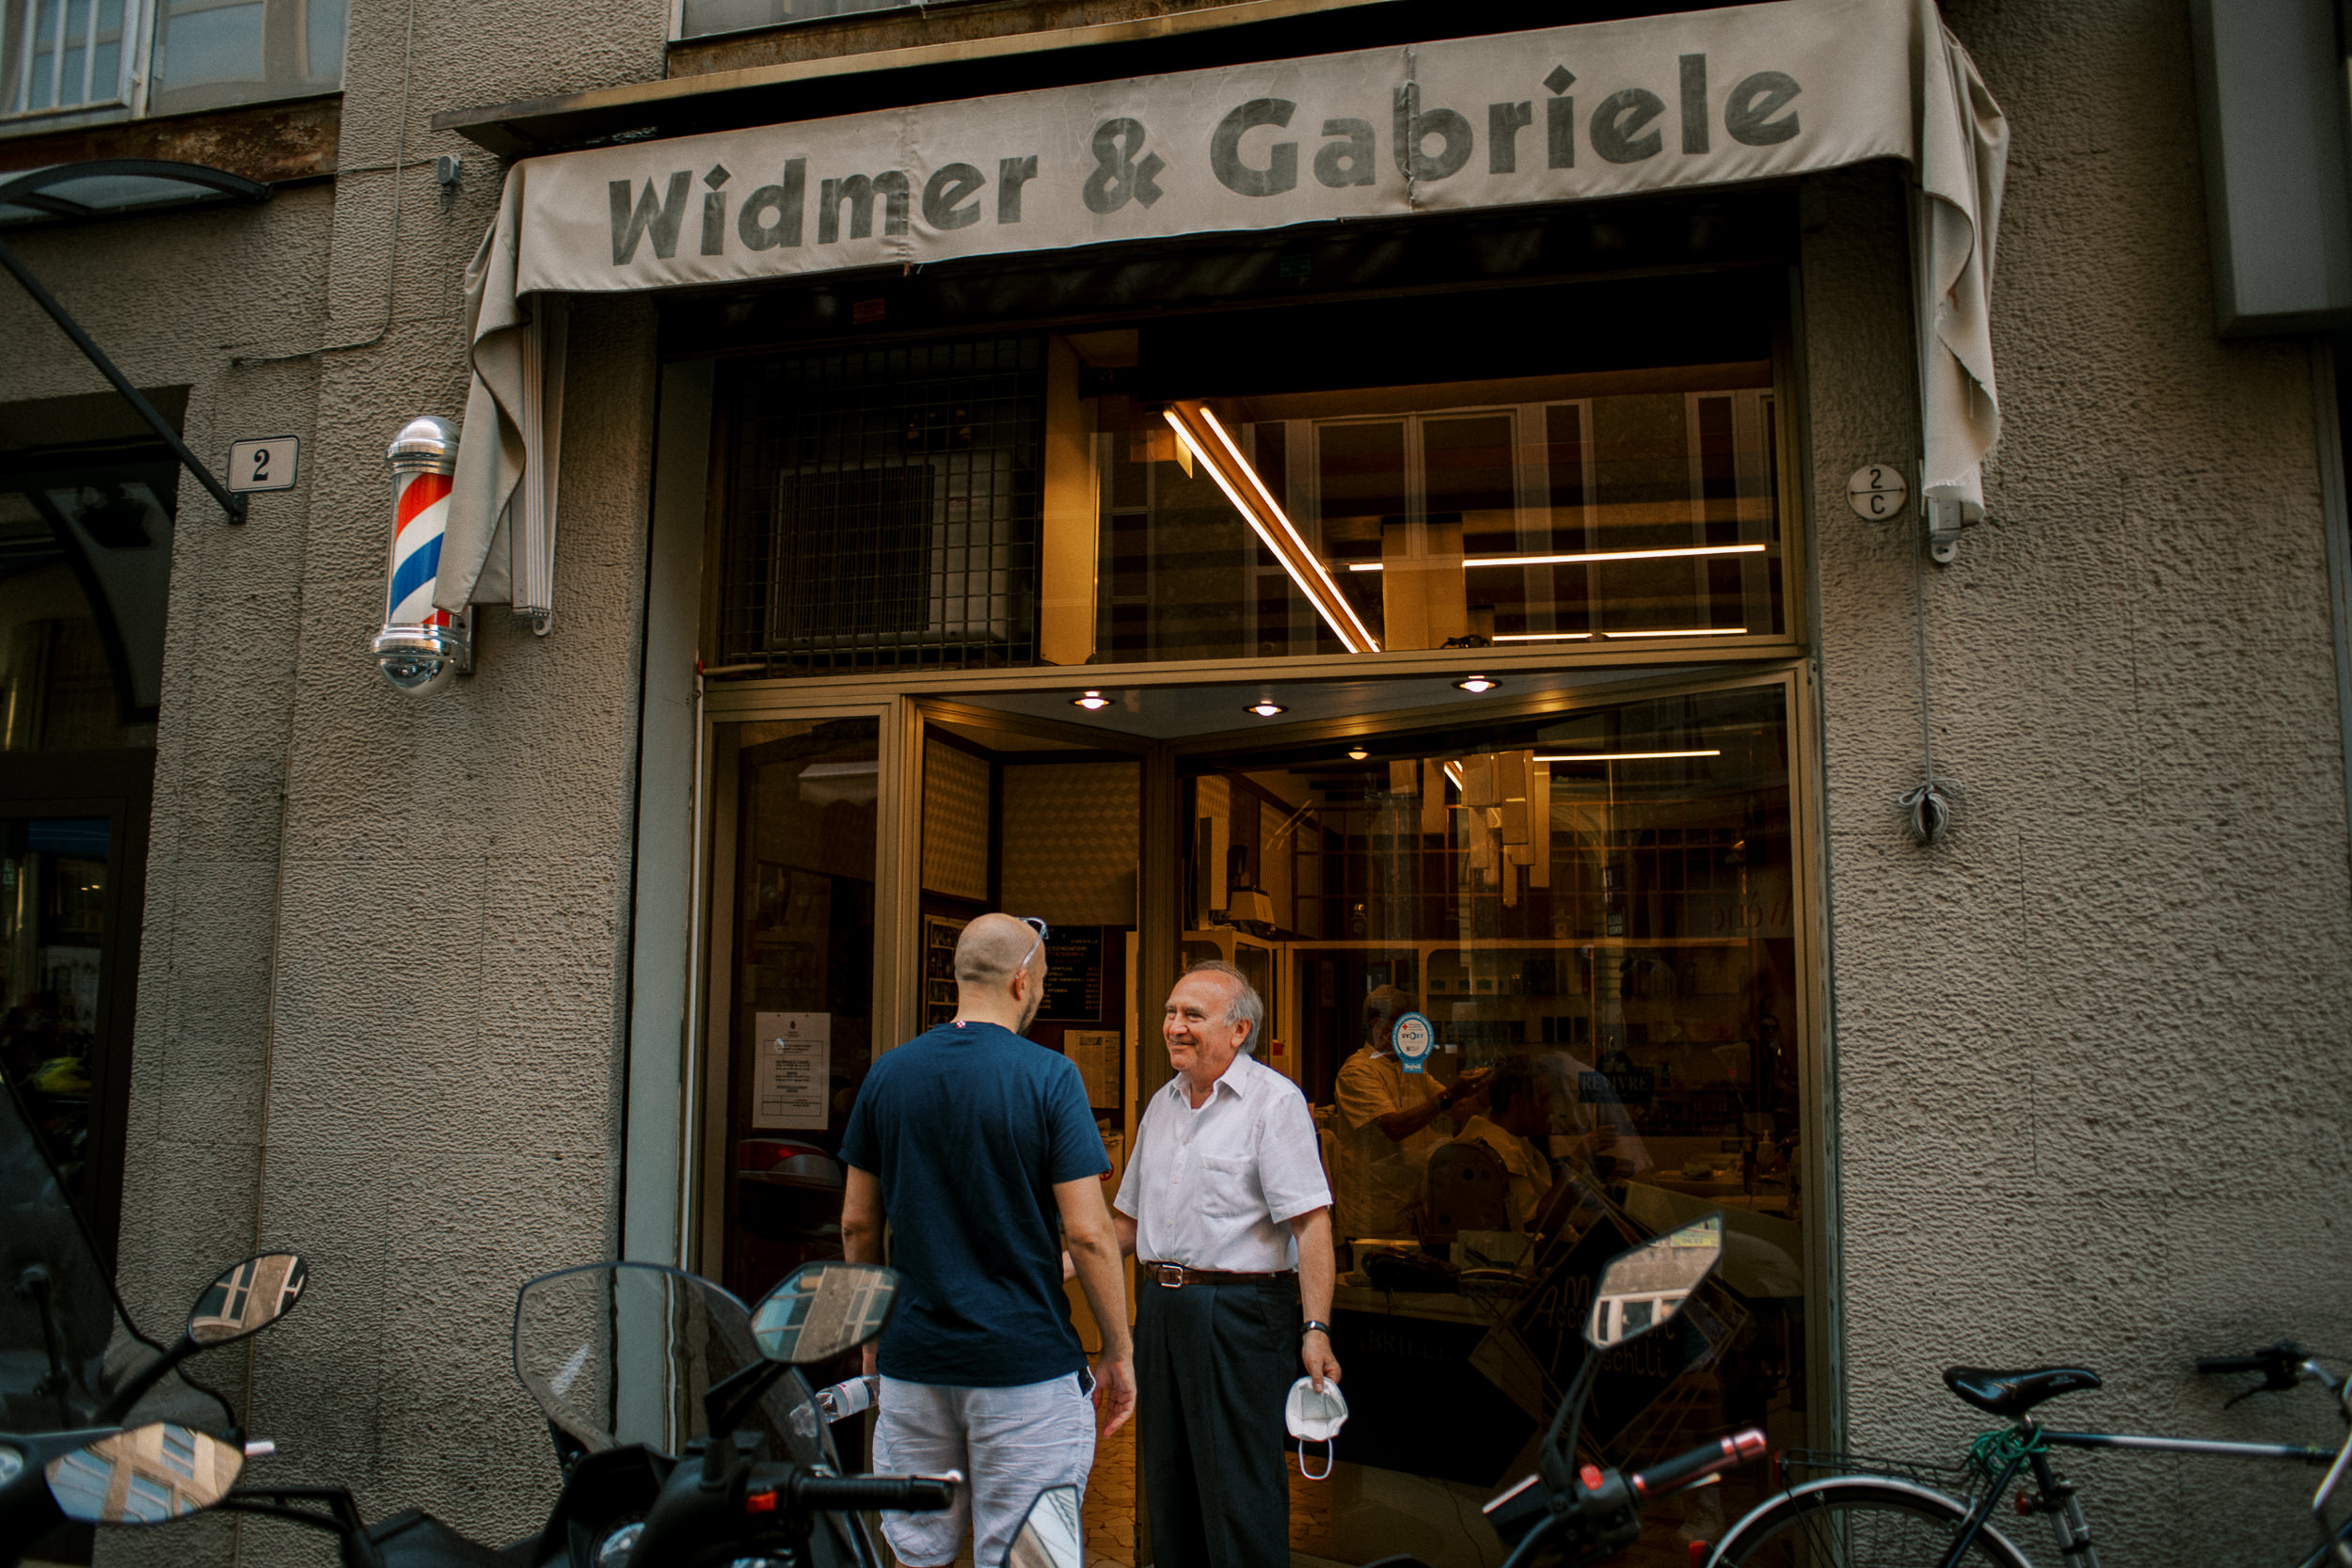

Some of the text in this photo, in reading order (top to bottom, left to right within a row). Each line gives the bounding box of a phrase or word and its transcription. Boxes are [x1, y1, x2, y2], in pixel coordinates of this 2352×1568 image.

[608, 53, 1803, 266] Widmer & Gabriele
[252, 448, 270, 482] 2
[1869, 468, 1883, 489] 2
[1870, 495, 1885, 515] C
